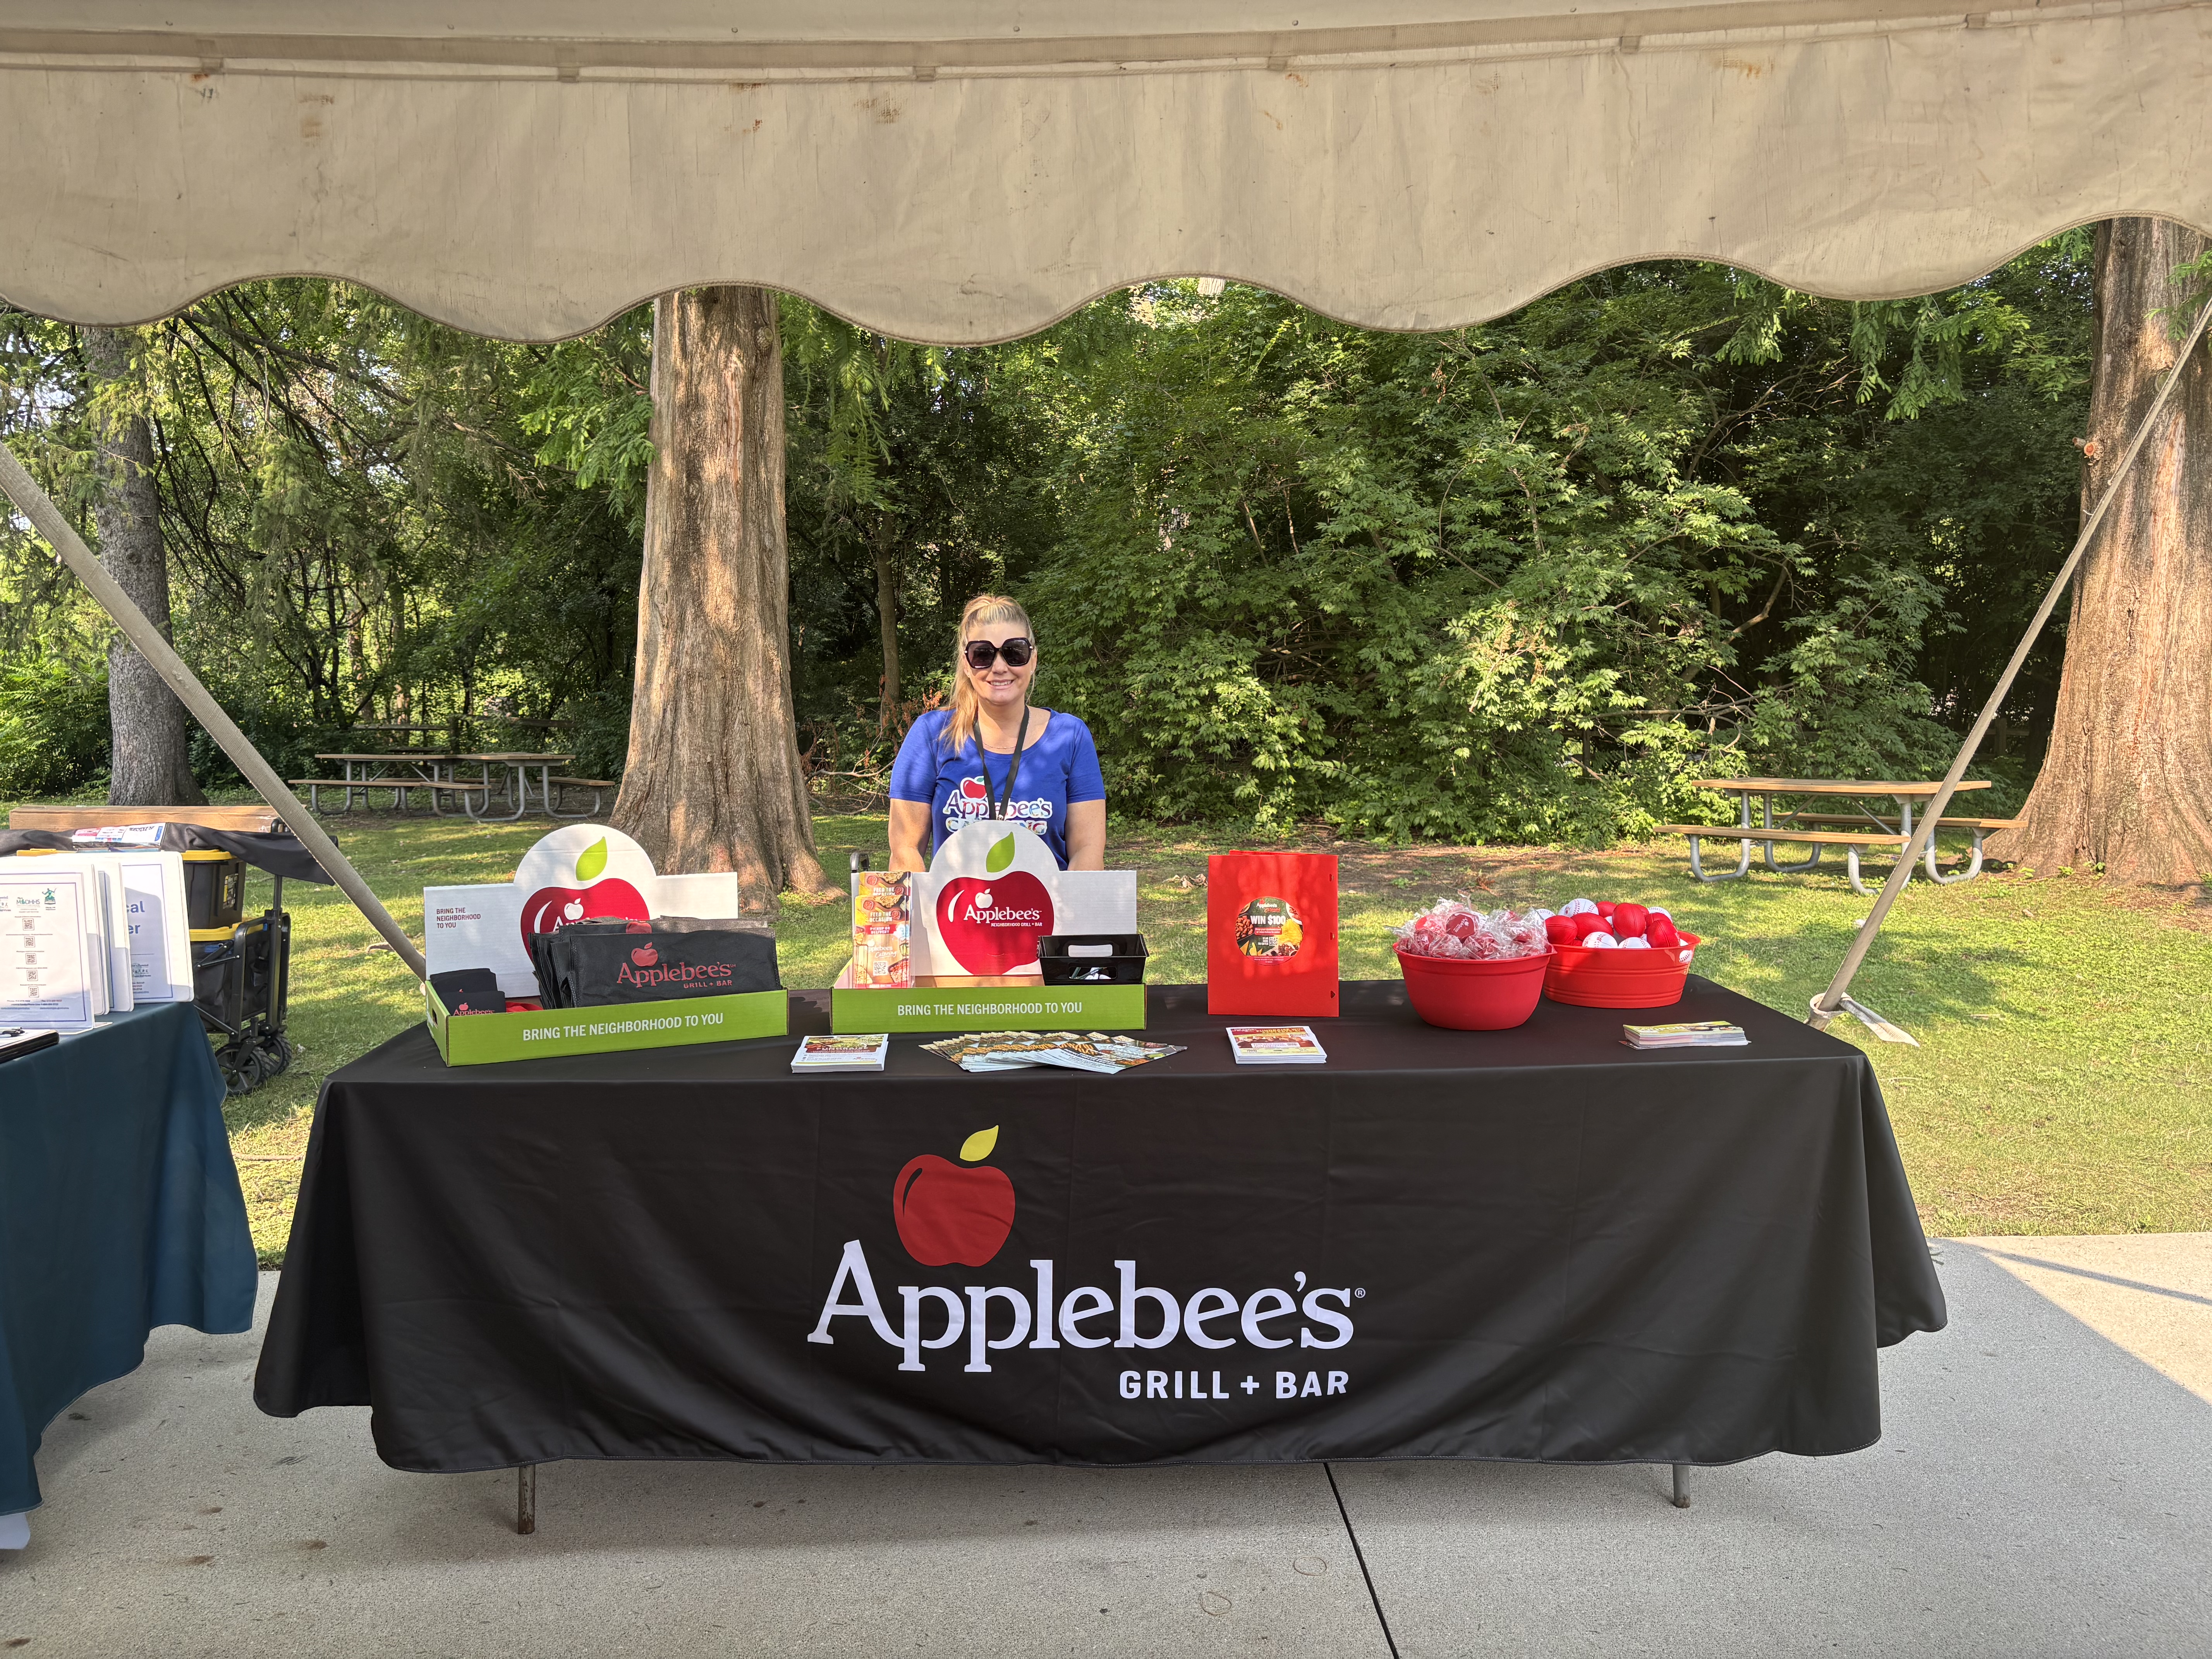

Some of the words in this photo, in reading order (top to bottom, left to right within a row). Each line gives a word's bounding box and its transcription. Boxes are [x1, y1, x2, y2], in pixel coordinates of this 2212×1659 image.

[436, 914, 481, 922] NEIGHBORHOOD
[963, 904, 1040, 923] Applebee's
[1250, 915, 1266, 924] WIN
[1267, 915, 1286, 925] $100
[898, 1004, 930, 1015] BRING
[934, 1004, 954, 1015] THE
[957, 1003, 1042, 1015] NEIGHBORHOOD
[1045, 1002, 1058, 1013] TO
[1061, 1002, 1082, 1013] YOU
[523, 1027, 560, 1041] BRING
[563, 1025, 586, 1038] THE
[589, 1017, 682, 1036] NEIGHBORHOOD
[685, 1015, 698, 1027] TO
[701, 1012, 723, 1025] YOU
[1119, 1370, 1229, 1400] GRILL
[1275, 1370, 1349, 1399] BAR
